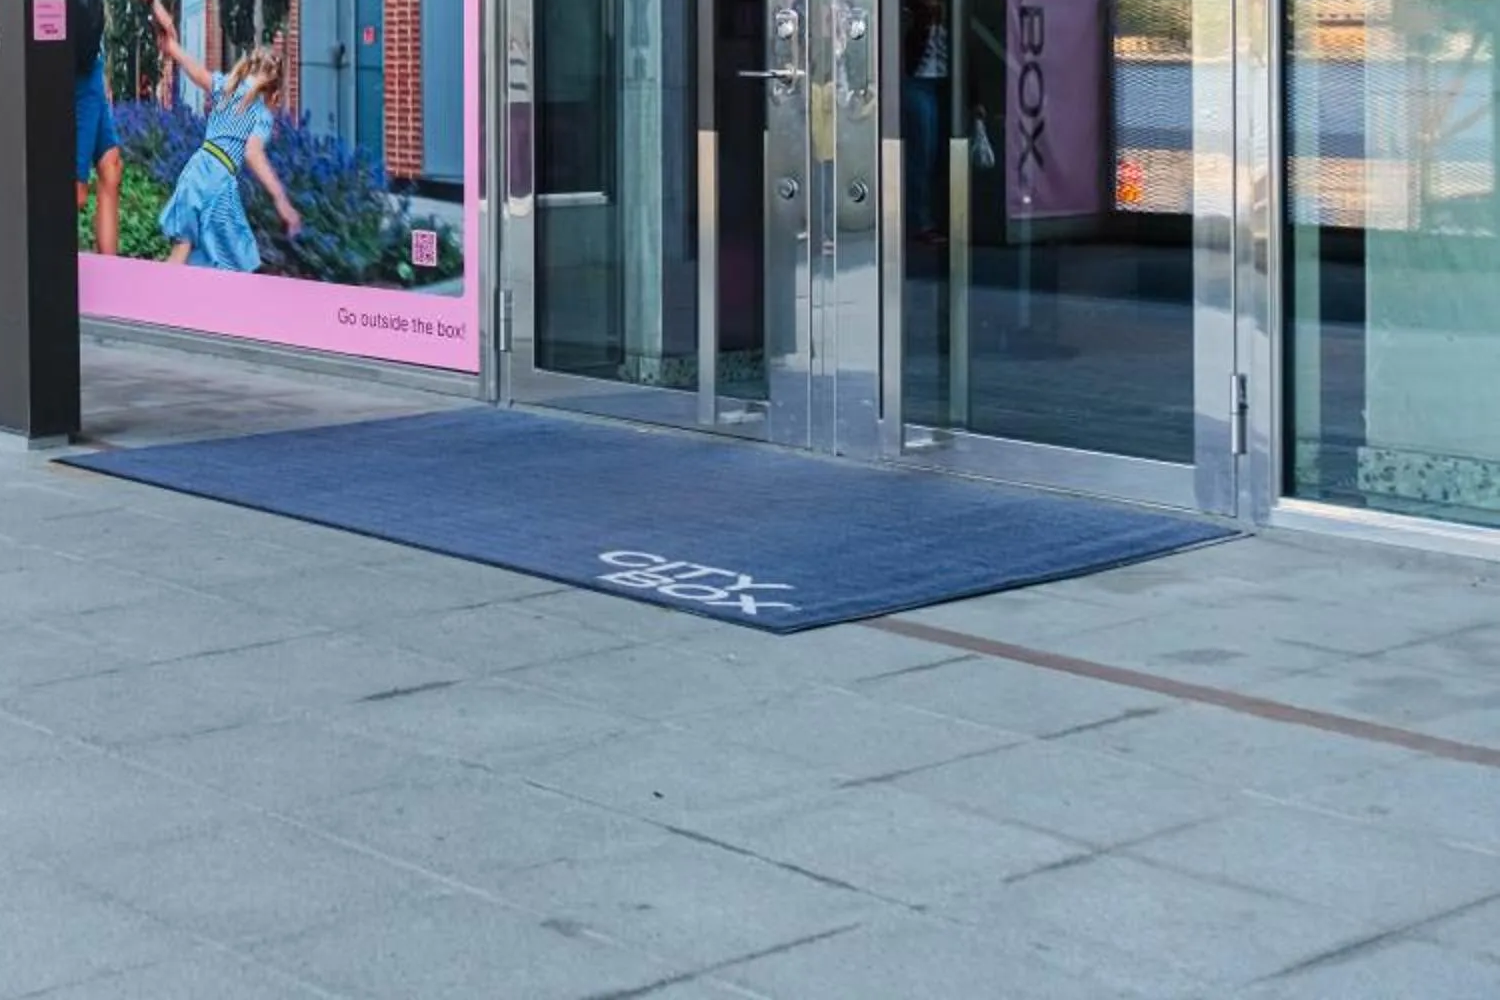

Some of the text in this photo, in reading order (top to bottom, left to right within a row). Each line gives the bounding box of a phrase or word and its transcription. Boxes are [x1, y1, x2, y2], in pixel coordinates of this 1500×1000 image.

[338, 308, 466, 339] Go outside the box!
[598, 551, 795, 590] CITY
